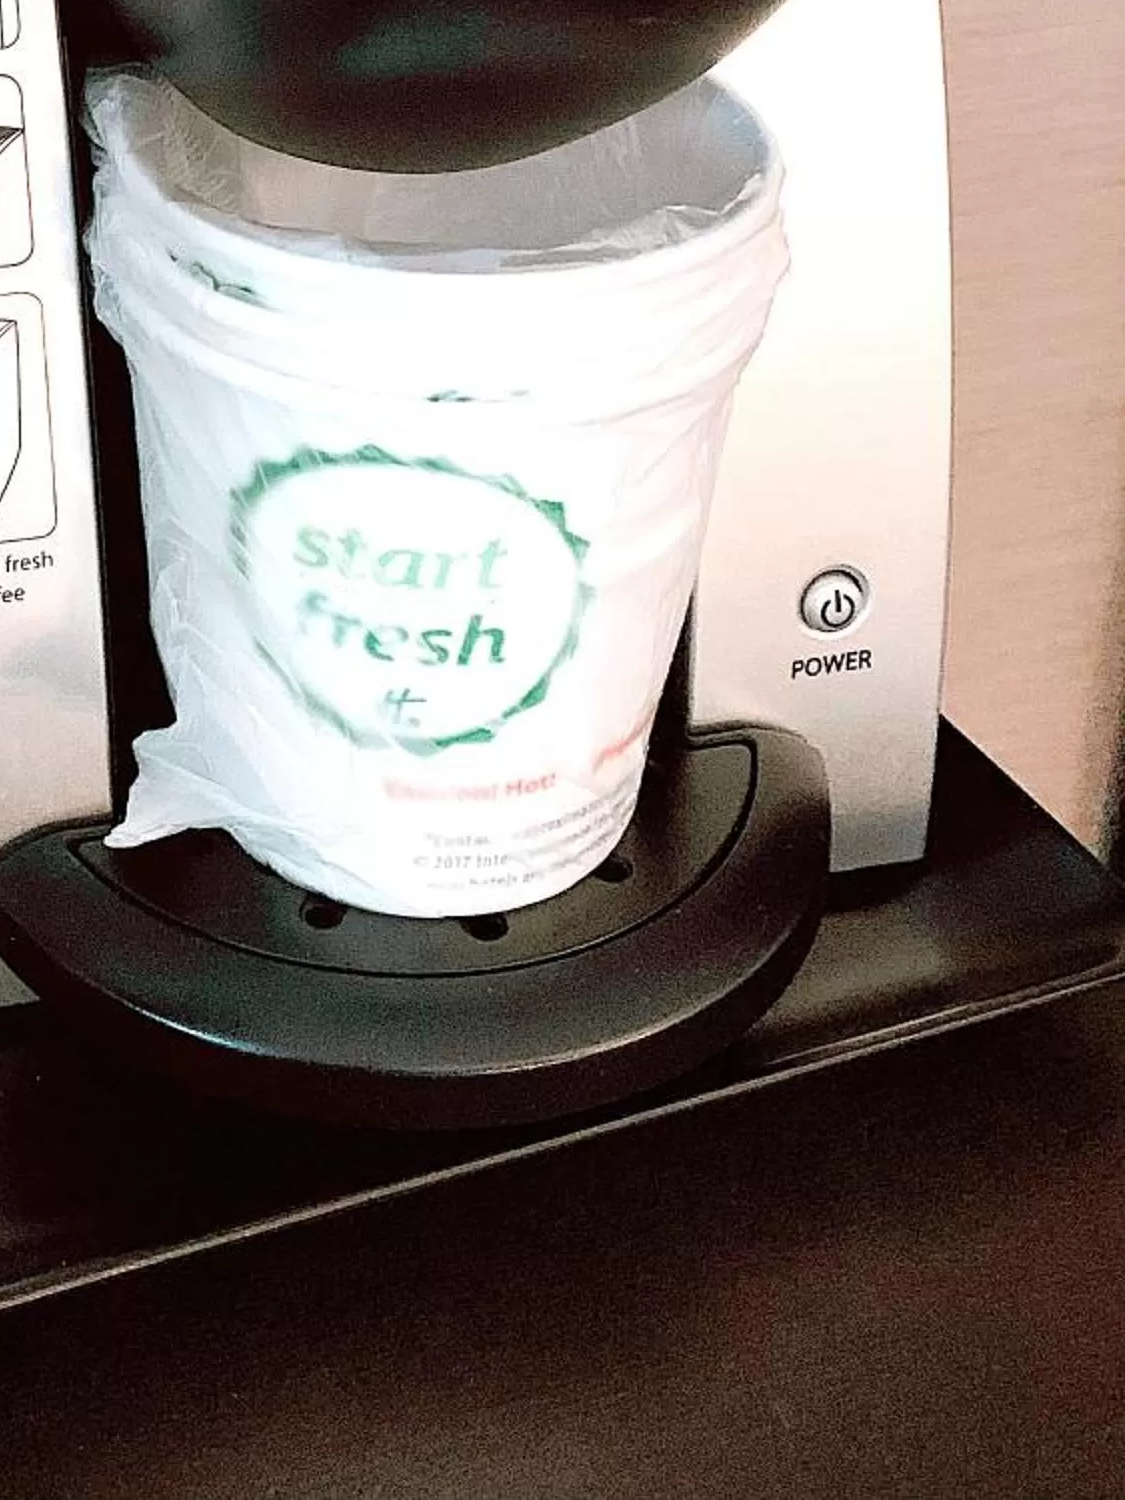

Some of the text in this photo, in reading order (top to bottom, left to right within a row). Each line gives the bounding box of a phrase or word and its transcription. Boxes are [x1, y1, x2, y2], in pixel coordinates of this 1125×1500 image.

[4, 550, 55, 574] fresh
[293, 524, 509, 590] start
[295, 590, 508, 666] fresh
[791, 649, 872, 679] POWER
